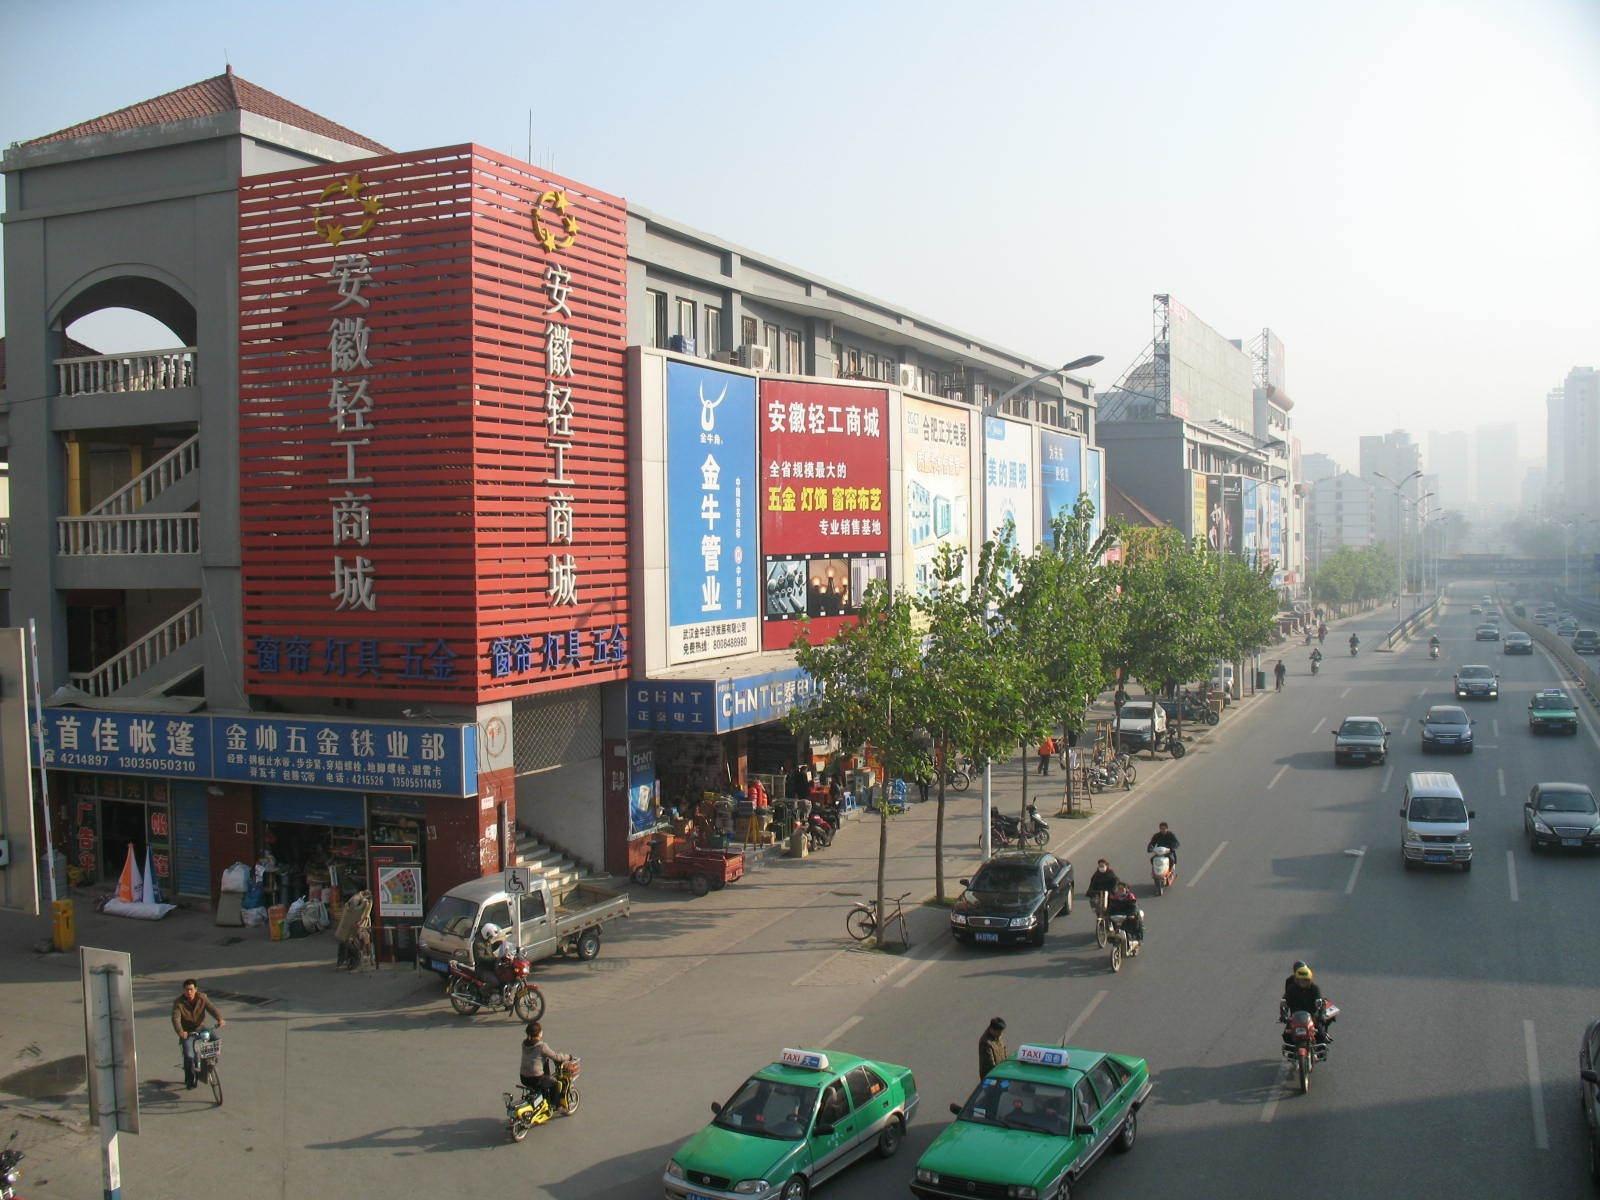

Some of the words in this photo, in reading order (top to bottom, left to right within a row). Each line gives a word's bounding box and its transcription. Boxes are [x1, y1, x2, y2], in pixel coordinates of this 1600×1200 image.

[327, 255, 376, 611] 安徽轻工商城
[542, 263, 578, 606] 安徽轻工商城
[768, 399, 880, 437] 安徽轻工商城
[769, 460, 847, 479] 全省规模最大的
[768, 486, 796, 512] 五金
[801, 486, 828, 512] 灯饰
[832, 486, 882, 512] 窗帘布艺
[701, 453, 721, 612] 金牛管业
[819, 519, 882, 536] 专业销售基地
[254, 634, 312, 674] 窗帘
[324, 637, 382, 677] 灯具
[400, 638, 458, 681] 五金
[491, 634, 533, 678] 窗帘
[542, 629, 580, 669] 灯具
[592, 623, 628, 664] 五金
[56, 715, 195, 757] 首佳帐篷
[226, 723, 445, 761] 金帅五金铁业部
[60, 752, 109, 767] 4214897
[119, 756, 196, 772] 13035050310
[783, 1052, 800, 1062] TAXI
[1022, 1049, 1041, 1059] TAXI
